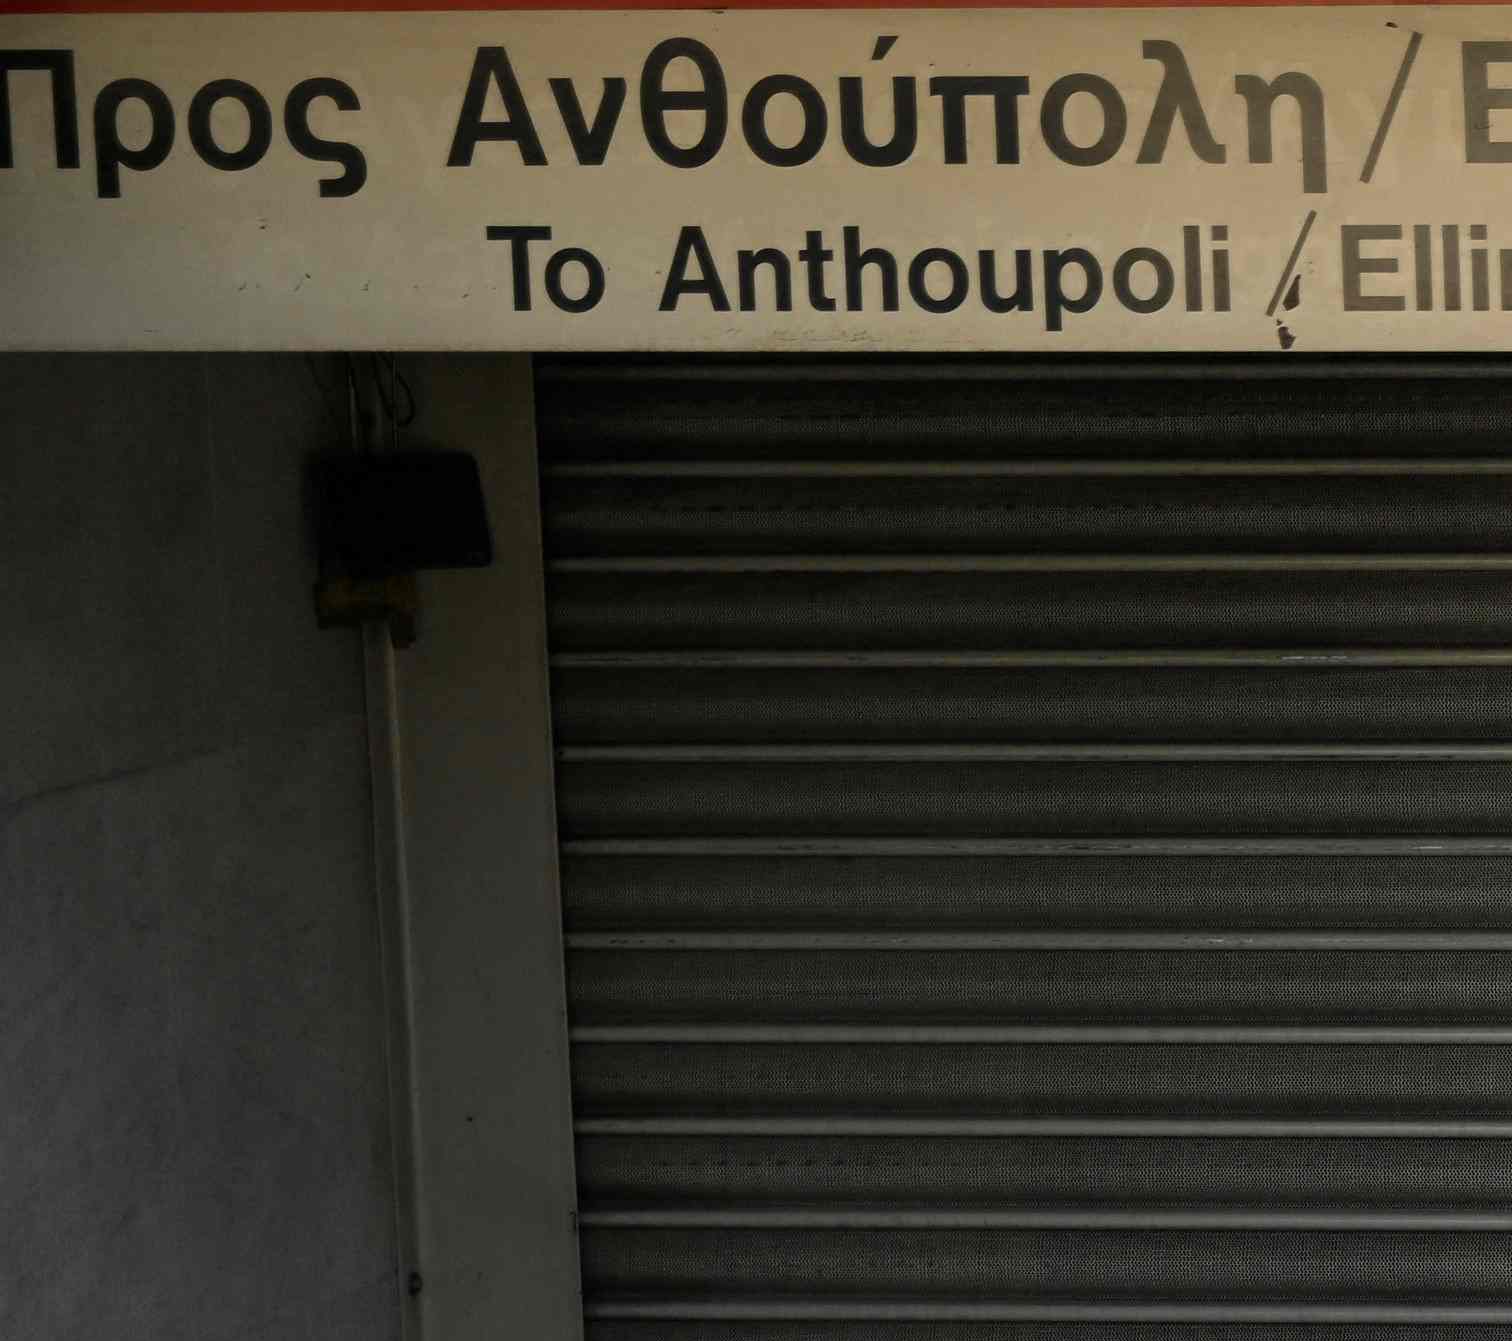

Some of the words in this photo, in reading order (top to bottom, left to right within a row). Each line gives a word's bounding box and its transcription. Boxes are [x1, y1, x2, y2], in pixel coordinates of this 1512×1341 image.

[0, 48, 368, 199] Προς
[446, 35, 1328, 194] Ανθούπολη
[486, 225, 606, 314] To
[657, 225, 1231, 332] Anthoupoli
